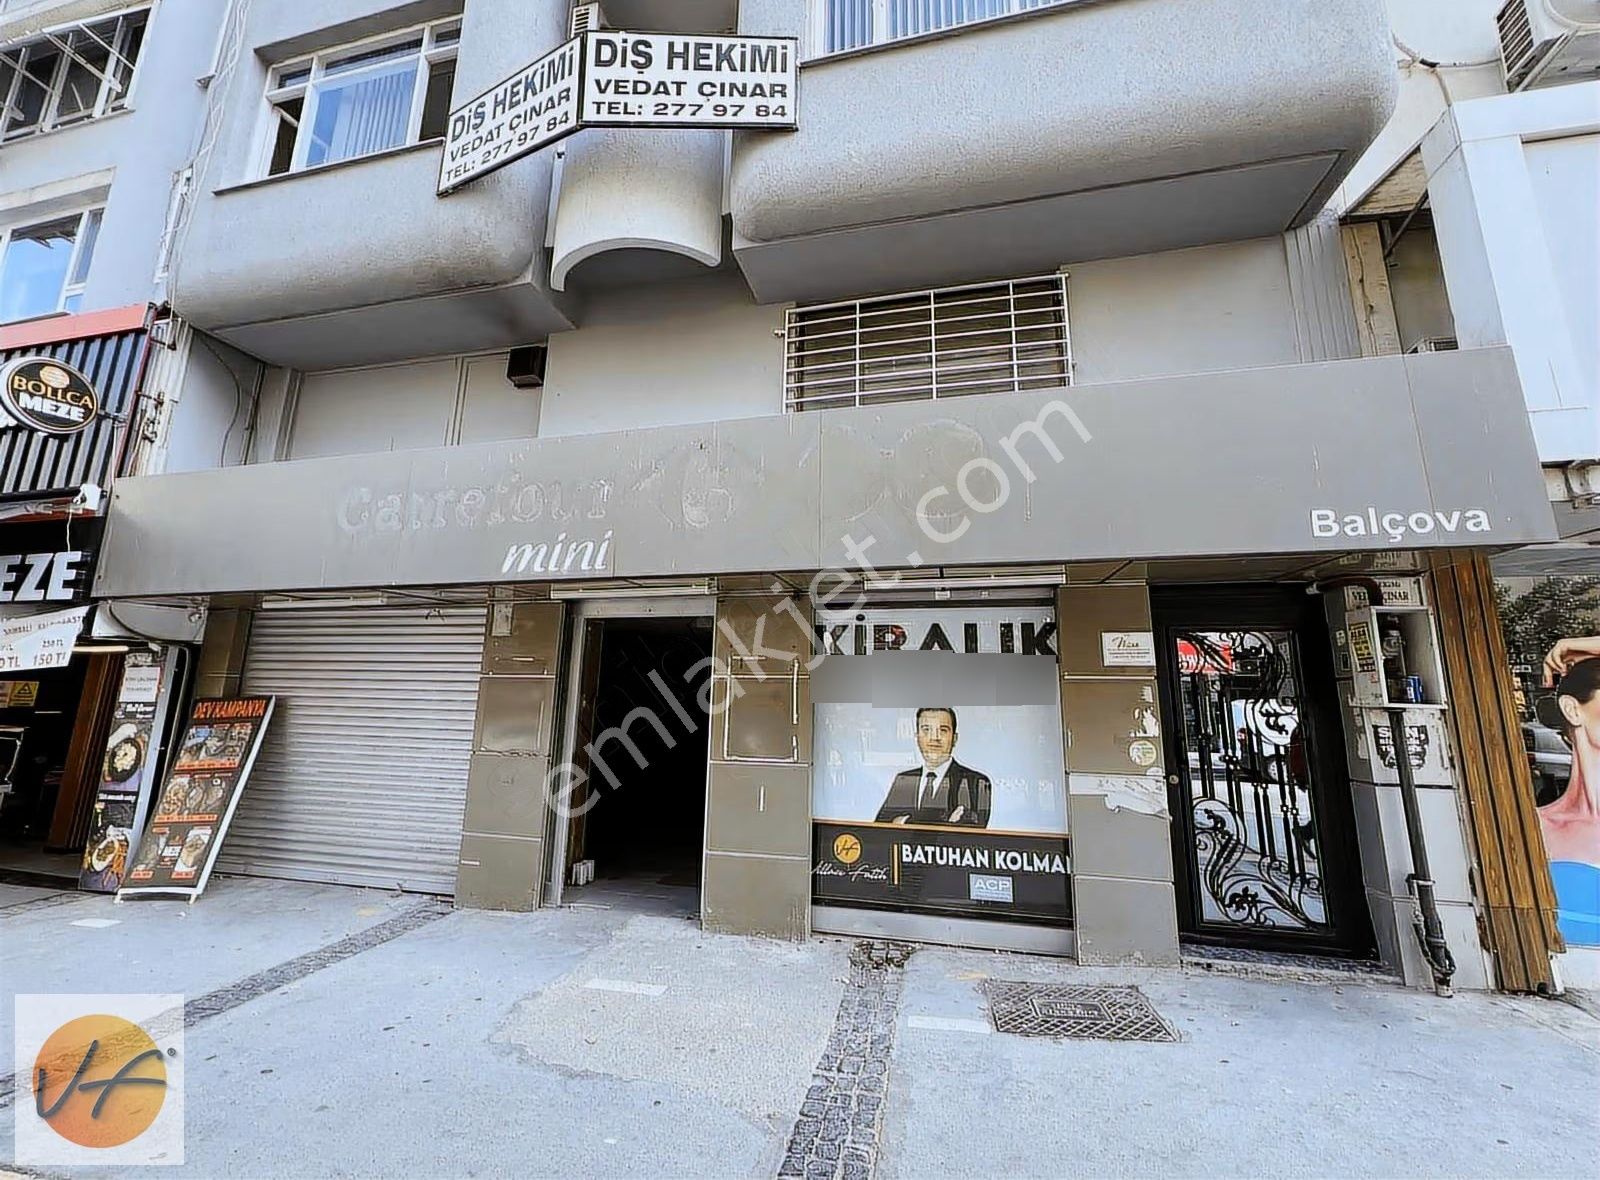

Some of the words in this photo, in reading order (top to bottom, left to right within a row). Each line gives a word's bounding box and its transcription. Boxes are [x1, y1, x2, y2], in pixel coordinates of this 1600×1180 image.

[594, 79, 687, 98] VEDAT
[697, 80, 788, 102] ÇINAR
[592, 101, 643, 116] TEL:
[653, 103, 704, 117] 277
[712, 103, 742, 118] 97
[755, 104, 787, 118] 84
[445, 156, 475, 182] TEL:
[481, 139, 514, 166] 277
[516, 126, 539, 148] 97
[547, 111, 571, 133] 84
[449, 122, 505, 163] VEDAT
[19, 391, 85, 422] MEZE
[1310, 505, 1492, 543] Balçova
[502, 530, 614, 573] mini
[33, 653, 53, 666] 150
[901, 844, 990, 869] BATUHAN
